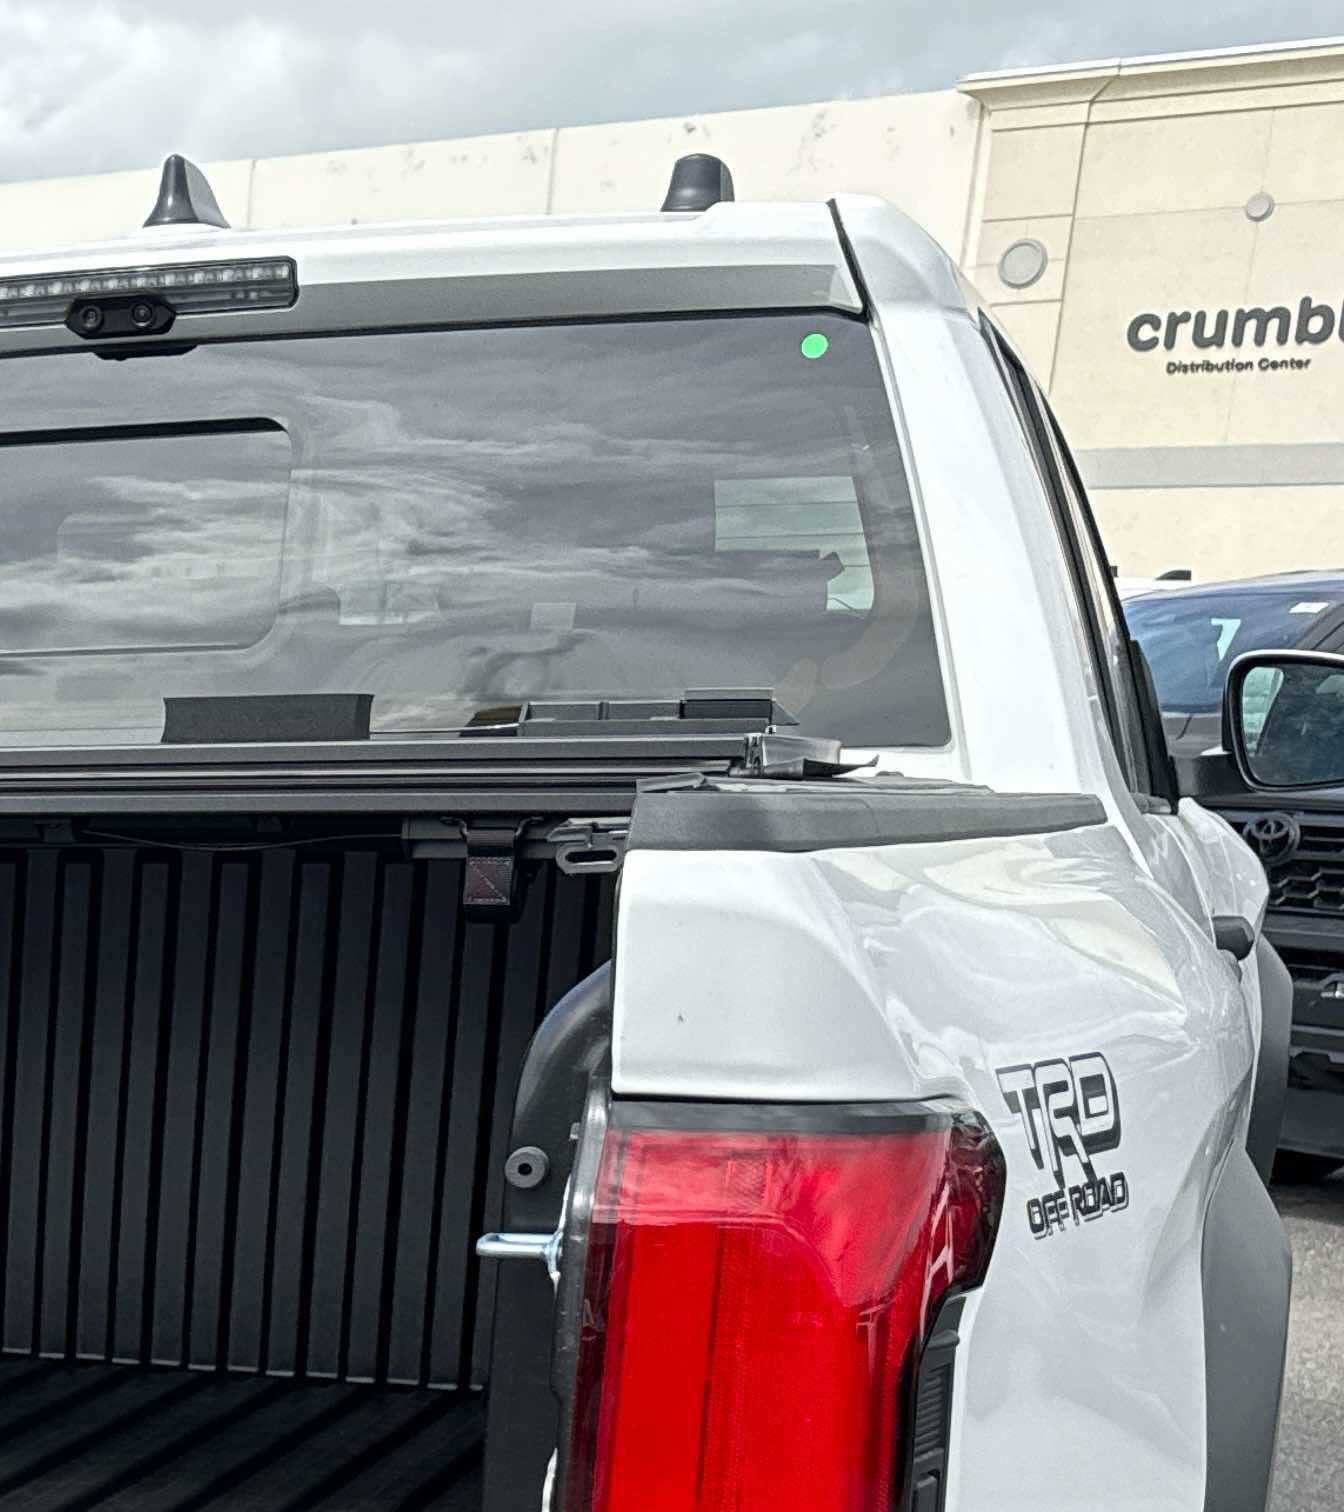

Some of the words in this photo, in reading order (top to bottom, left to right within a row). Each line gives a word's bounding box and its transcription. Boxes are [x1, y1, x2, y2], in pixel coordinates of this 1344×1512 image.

[1166, 359, 1253, 375] Distribution
[1257, 357, 1311, 371] Center
[995, 1051, 1121, 1189] TRD
[1068, 1171, 1129, 1227] ROAD
